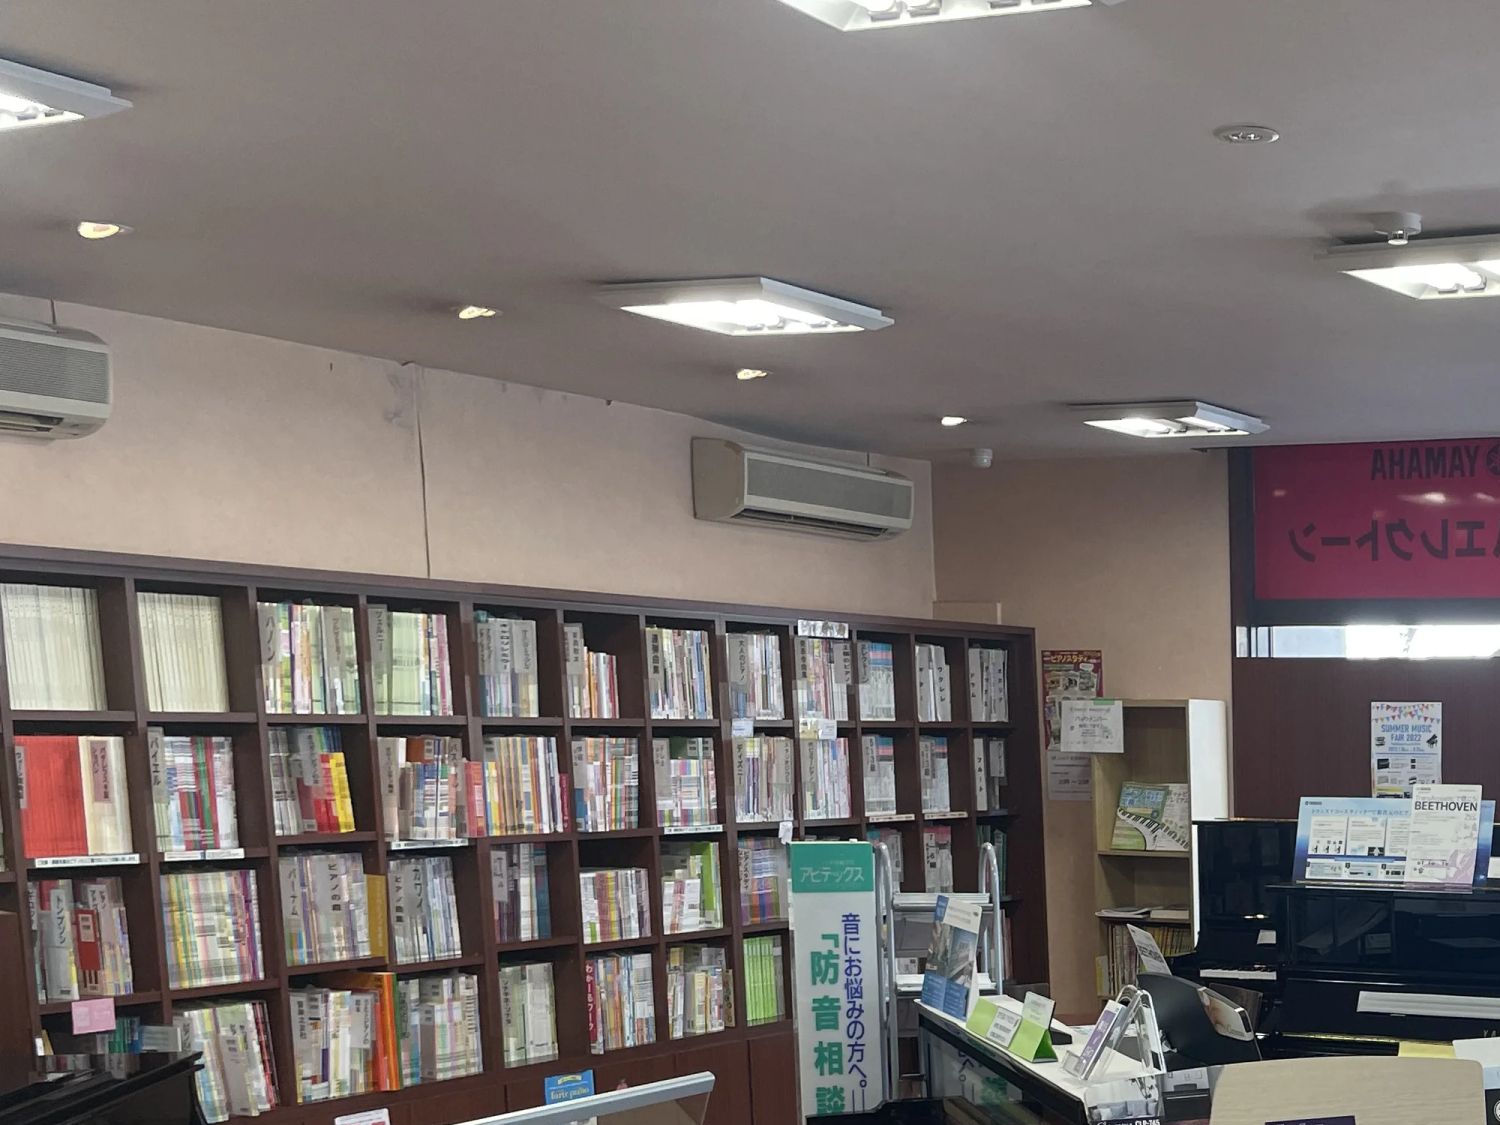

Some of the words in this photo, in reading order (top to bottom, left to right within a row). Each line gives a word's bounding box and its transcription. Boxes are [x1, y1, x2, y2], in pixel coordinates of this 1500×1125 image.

[1381, 724, 1409, 733] SUMMER
[1411, 724, 1432, 733] MUSIC
[1390, 734, 1405, 742] FAIR
[1406, 734, 1422, 742] 2022
[1414, 800, 1478, 812] BEETHOVEN
[841, 912, 868, 1089] 音にお悩みの方へ。
